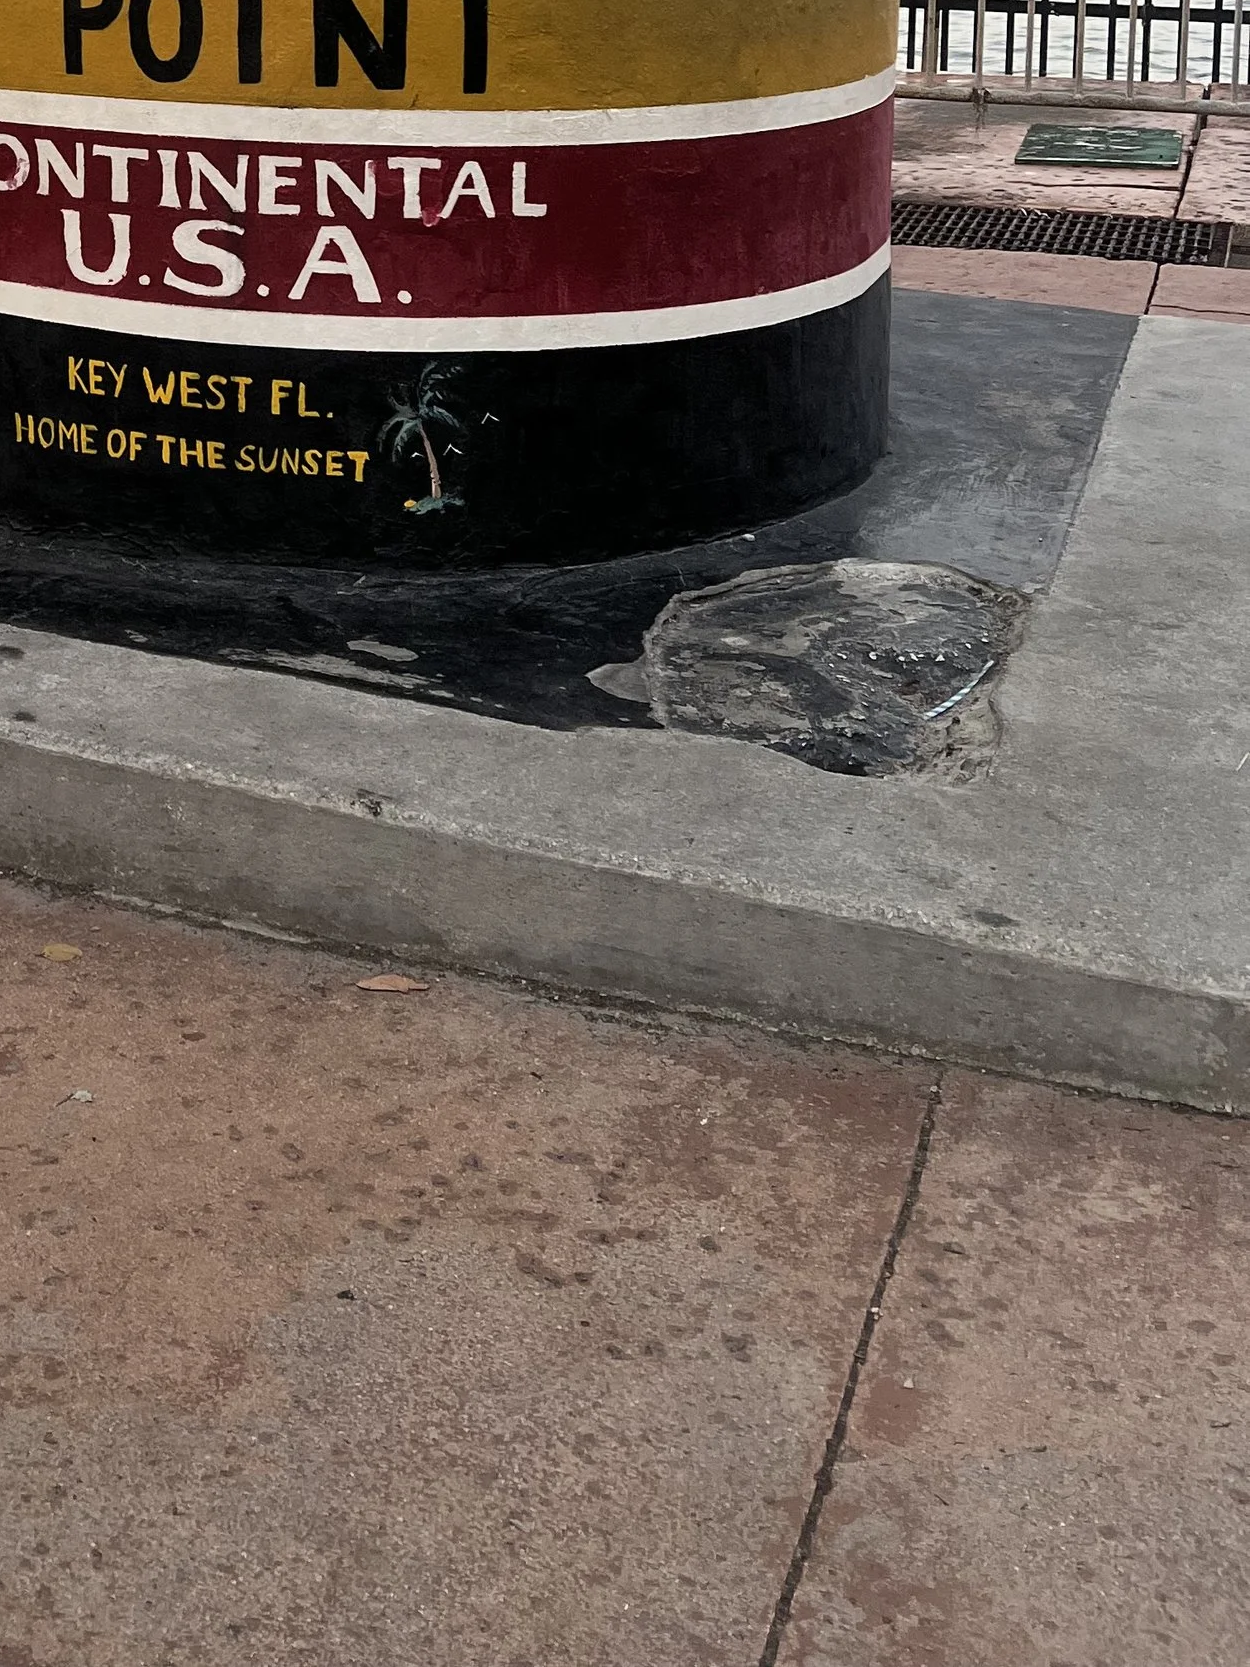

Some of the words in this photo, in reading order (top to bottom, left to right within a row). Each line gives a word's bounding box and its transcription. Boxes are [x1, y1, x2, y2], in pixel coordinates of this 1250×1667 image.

[60, 208, 413, 305] U.S.A.
[68, 356, 128, 398] KEY
[143, 367, 253, 413] WEST
[270, 379, 334, 418] FL.
[14, 412, 98, 455] HOME
[106, 428, 147, 461] OF
[156, 435, 226, 469] THE
[235, 445, 370, 483] SUNSET
